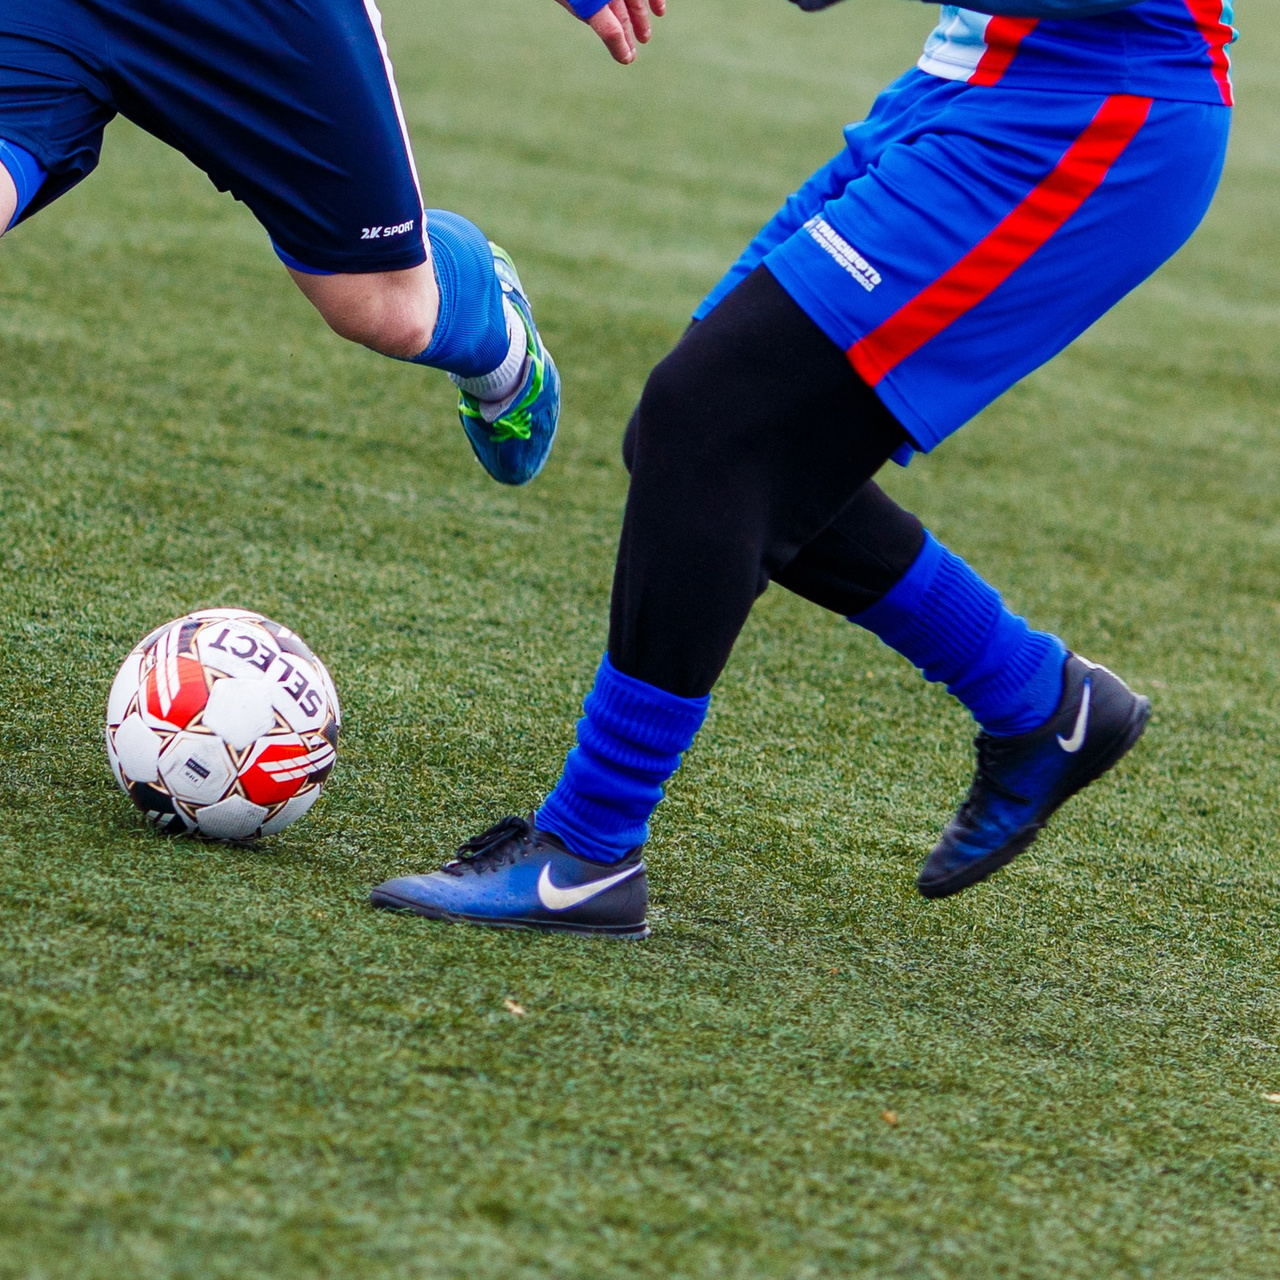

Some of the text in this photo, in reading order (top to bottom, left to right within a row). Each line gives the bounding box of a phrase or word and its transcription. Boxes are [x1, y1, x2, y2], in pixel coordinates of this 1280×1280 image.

[360, 219, 415, 240] 2K SPORT
[815, 219, 883, 286] ТРАНСНЕФТЬ
[207, 628, 323, 718] SELECT
